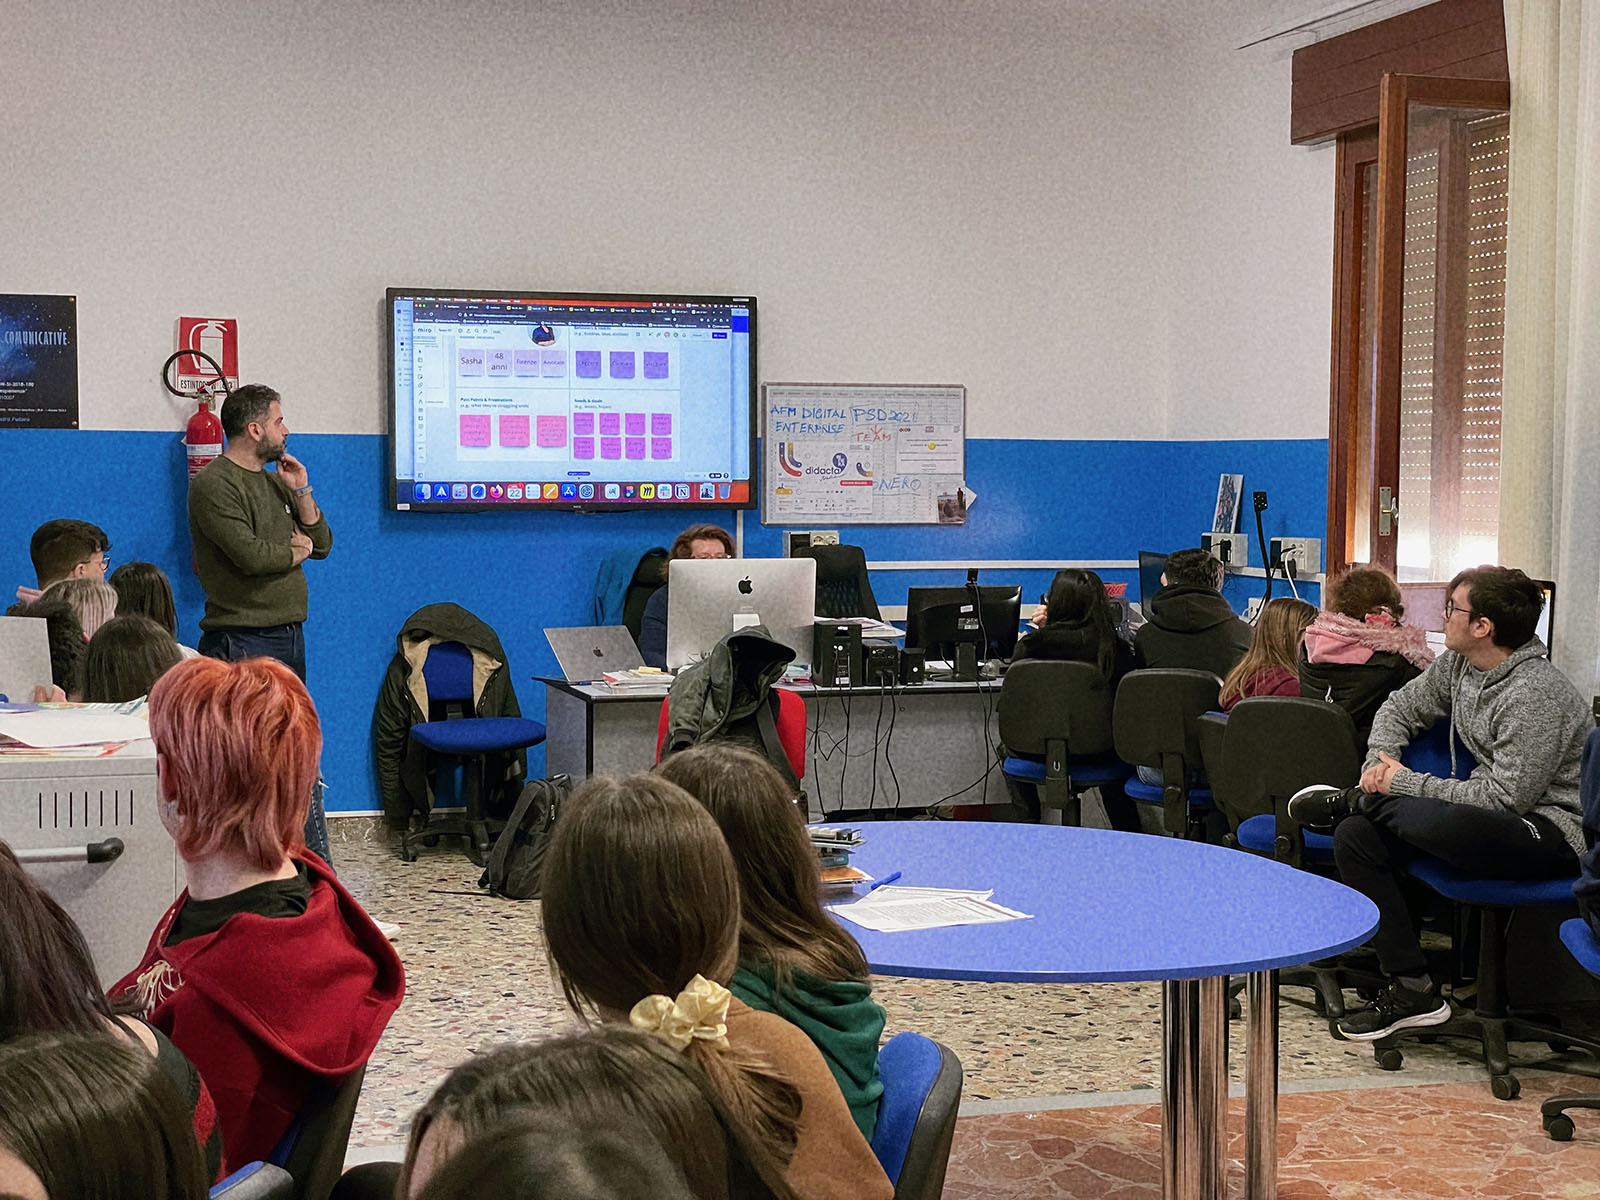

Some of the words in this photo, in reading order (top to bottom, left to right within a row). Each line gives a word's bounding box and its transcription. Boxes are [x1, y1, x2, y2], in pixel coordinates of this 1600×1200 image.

[5, 331, 67, 345] COMUNICATIVE
[494, 352, 504, 360] 48
[460, 357, 483, 365] Sasha
[770, 404, 797, 417] AFM
[802, 407, 847, 419] DIGITAL
[855, 432, 892, 442] TEAM
[805, 467, 841, 475] didacta
